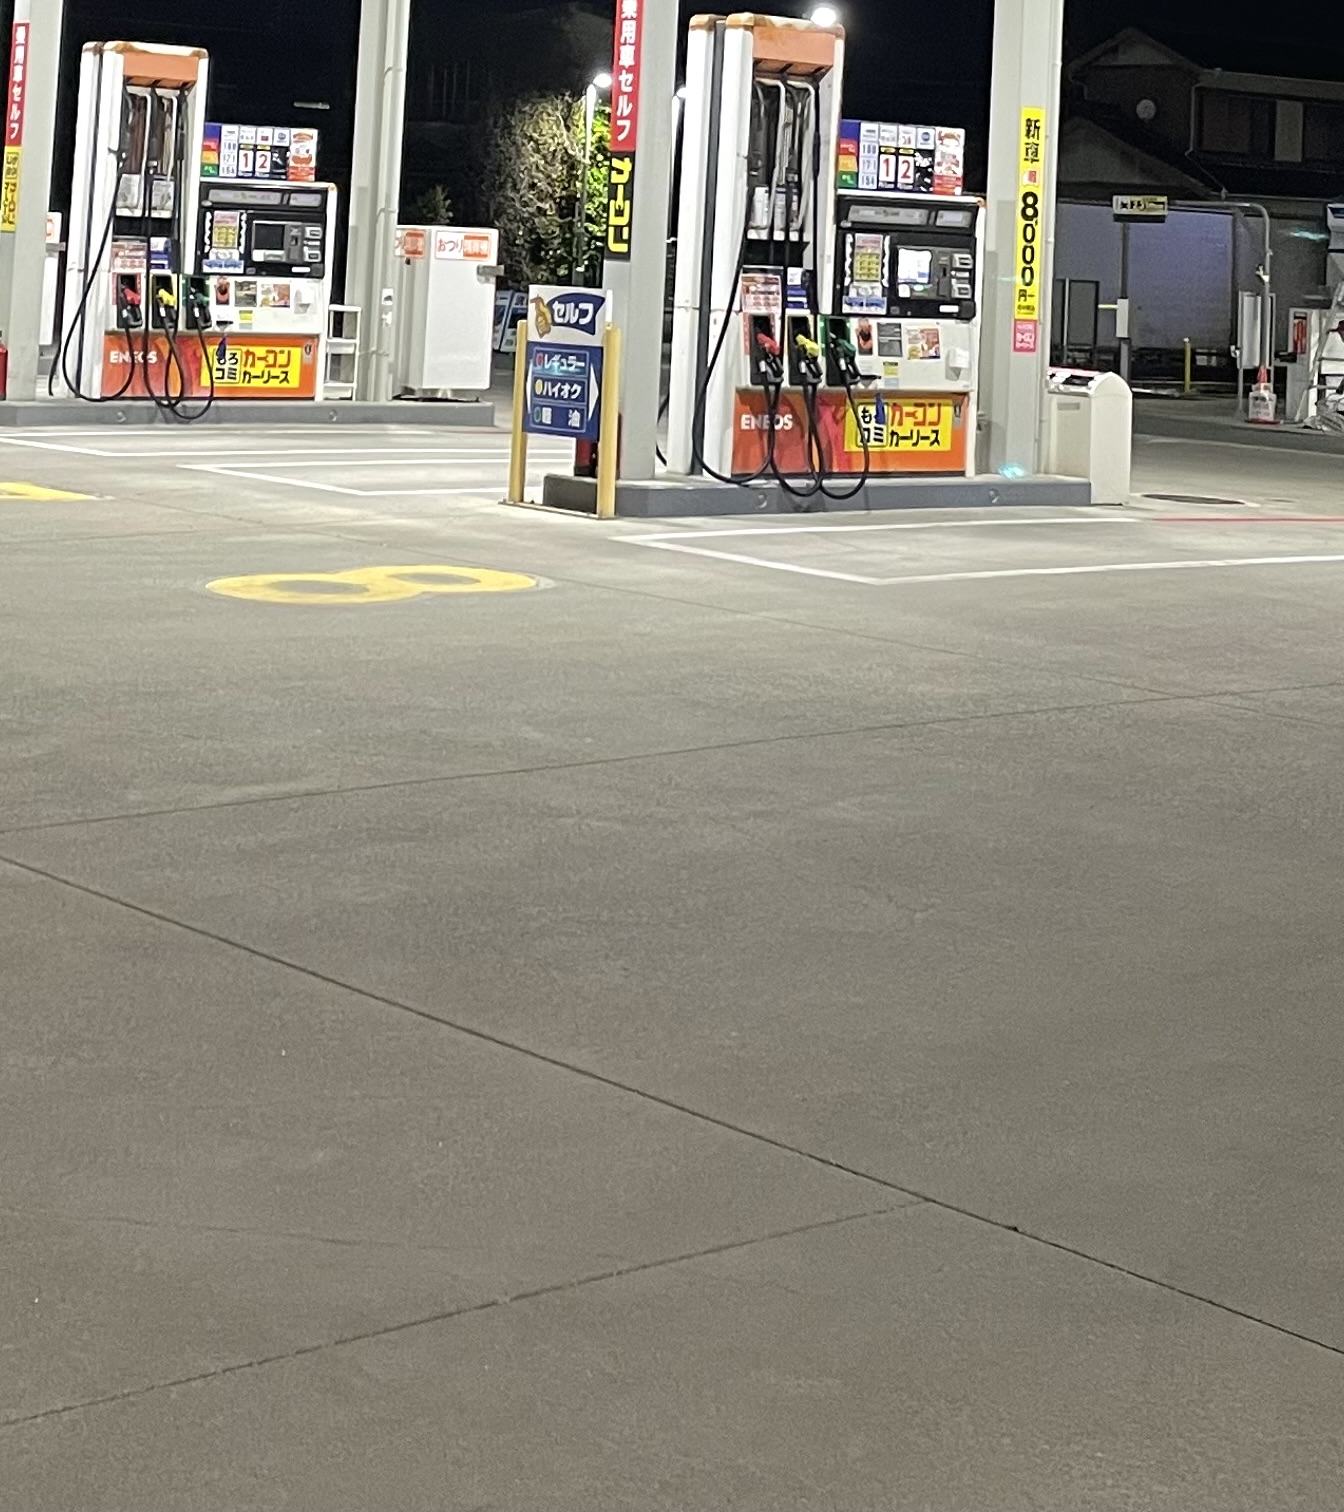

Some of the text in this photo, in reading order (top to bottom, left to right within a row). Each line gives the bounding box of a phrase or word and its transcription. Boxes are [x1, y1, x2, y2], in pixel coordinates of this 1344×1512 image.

[608, 157, 633, 253] カーコン
[552, 300, 594, 326] セルフ
[243, 349, 292, 369] カーコン
[544, 353, 586, 371] レギュラー
[242, 370, 290, 384] カーリース
[543, 380, 582, 399] ハイオク
[890, 402, 942, 427] カーコン
[889, 429, 941, 447] カーリース
[205, 564, 538, 605] 8
